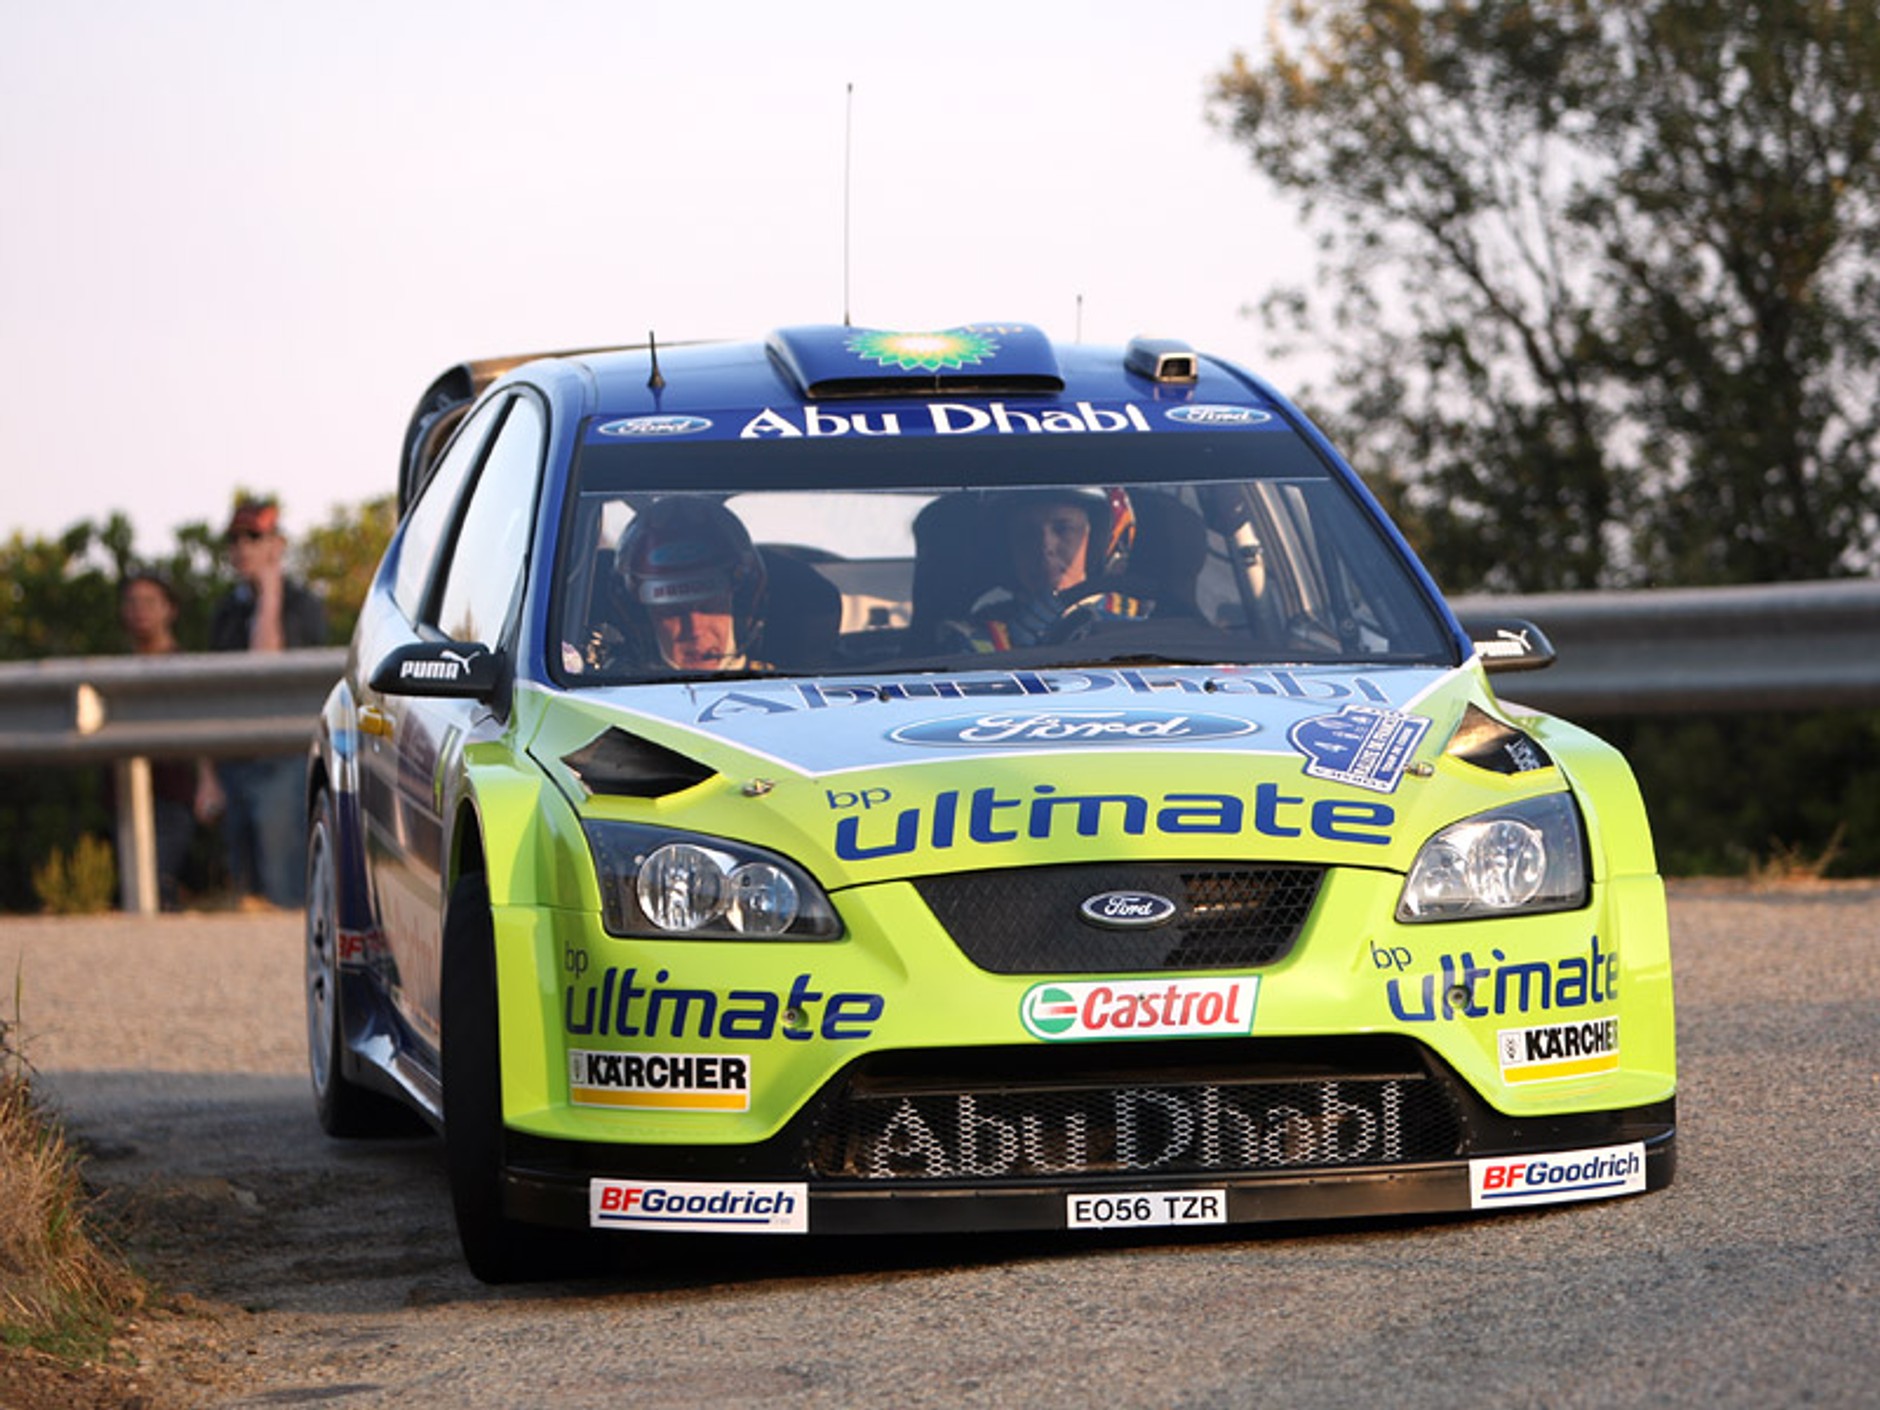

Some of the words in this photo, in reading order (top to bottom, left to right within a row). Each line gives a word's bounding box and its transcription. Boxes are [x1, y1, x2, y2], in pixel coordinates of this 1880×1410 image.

[740, 405, 902, 438] Abu
[931, 402, 1151, 435] Dhabi
[400, 661, 460, 679] PUMA
[1009, 669, 1390, 704] Dhabi
[957, 709, 1192, 743] Ford
[825, 786, 892, 811] bp
[834, 783, 1395, 861] ultimate
[1104, 897, 1154, 916] Ford
[564, 941, 589, 976] bp
[1370, 940, 1412, 971] bp
[1387, 935, 1618, 1021] ultimate
[565, 967, 885, 1040] ultimate
[1082, 984, 1240, 1030] Castrol
[587, 1054, 747, 1090] KÄRCHER
[869, 1094, 1086, 1177] Abu
[1113, 1081, 1403, 1170] Dhabi
[1483, 1152, 1640, 1190] BFGoodrich
[601, 1187, 796, 1214] BFGoodrich
[1075, 1198, 1152, 1223] EO56
[1163, 1195, 1220, 1220] TZR
